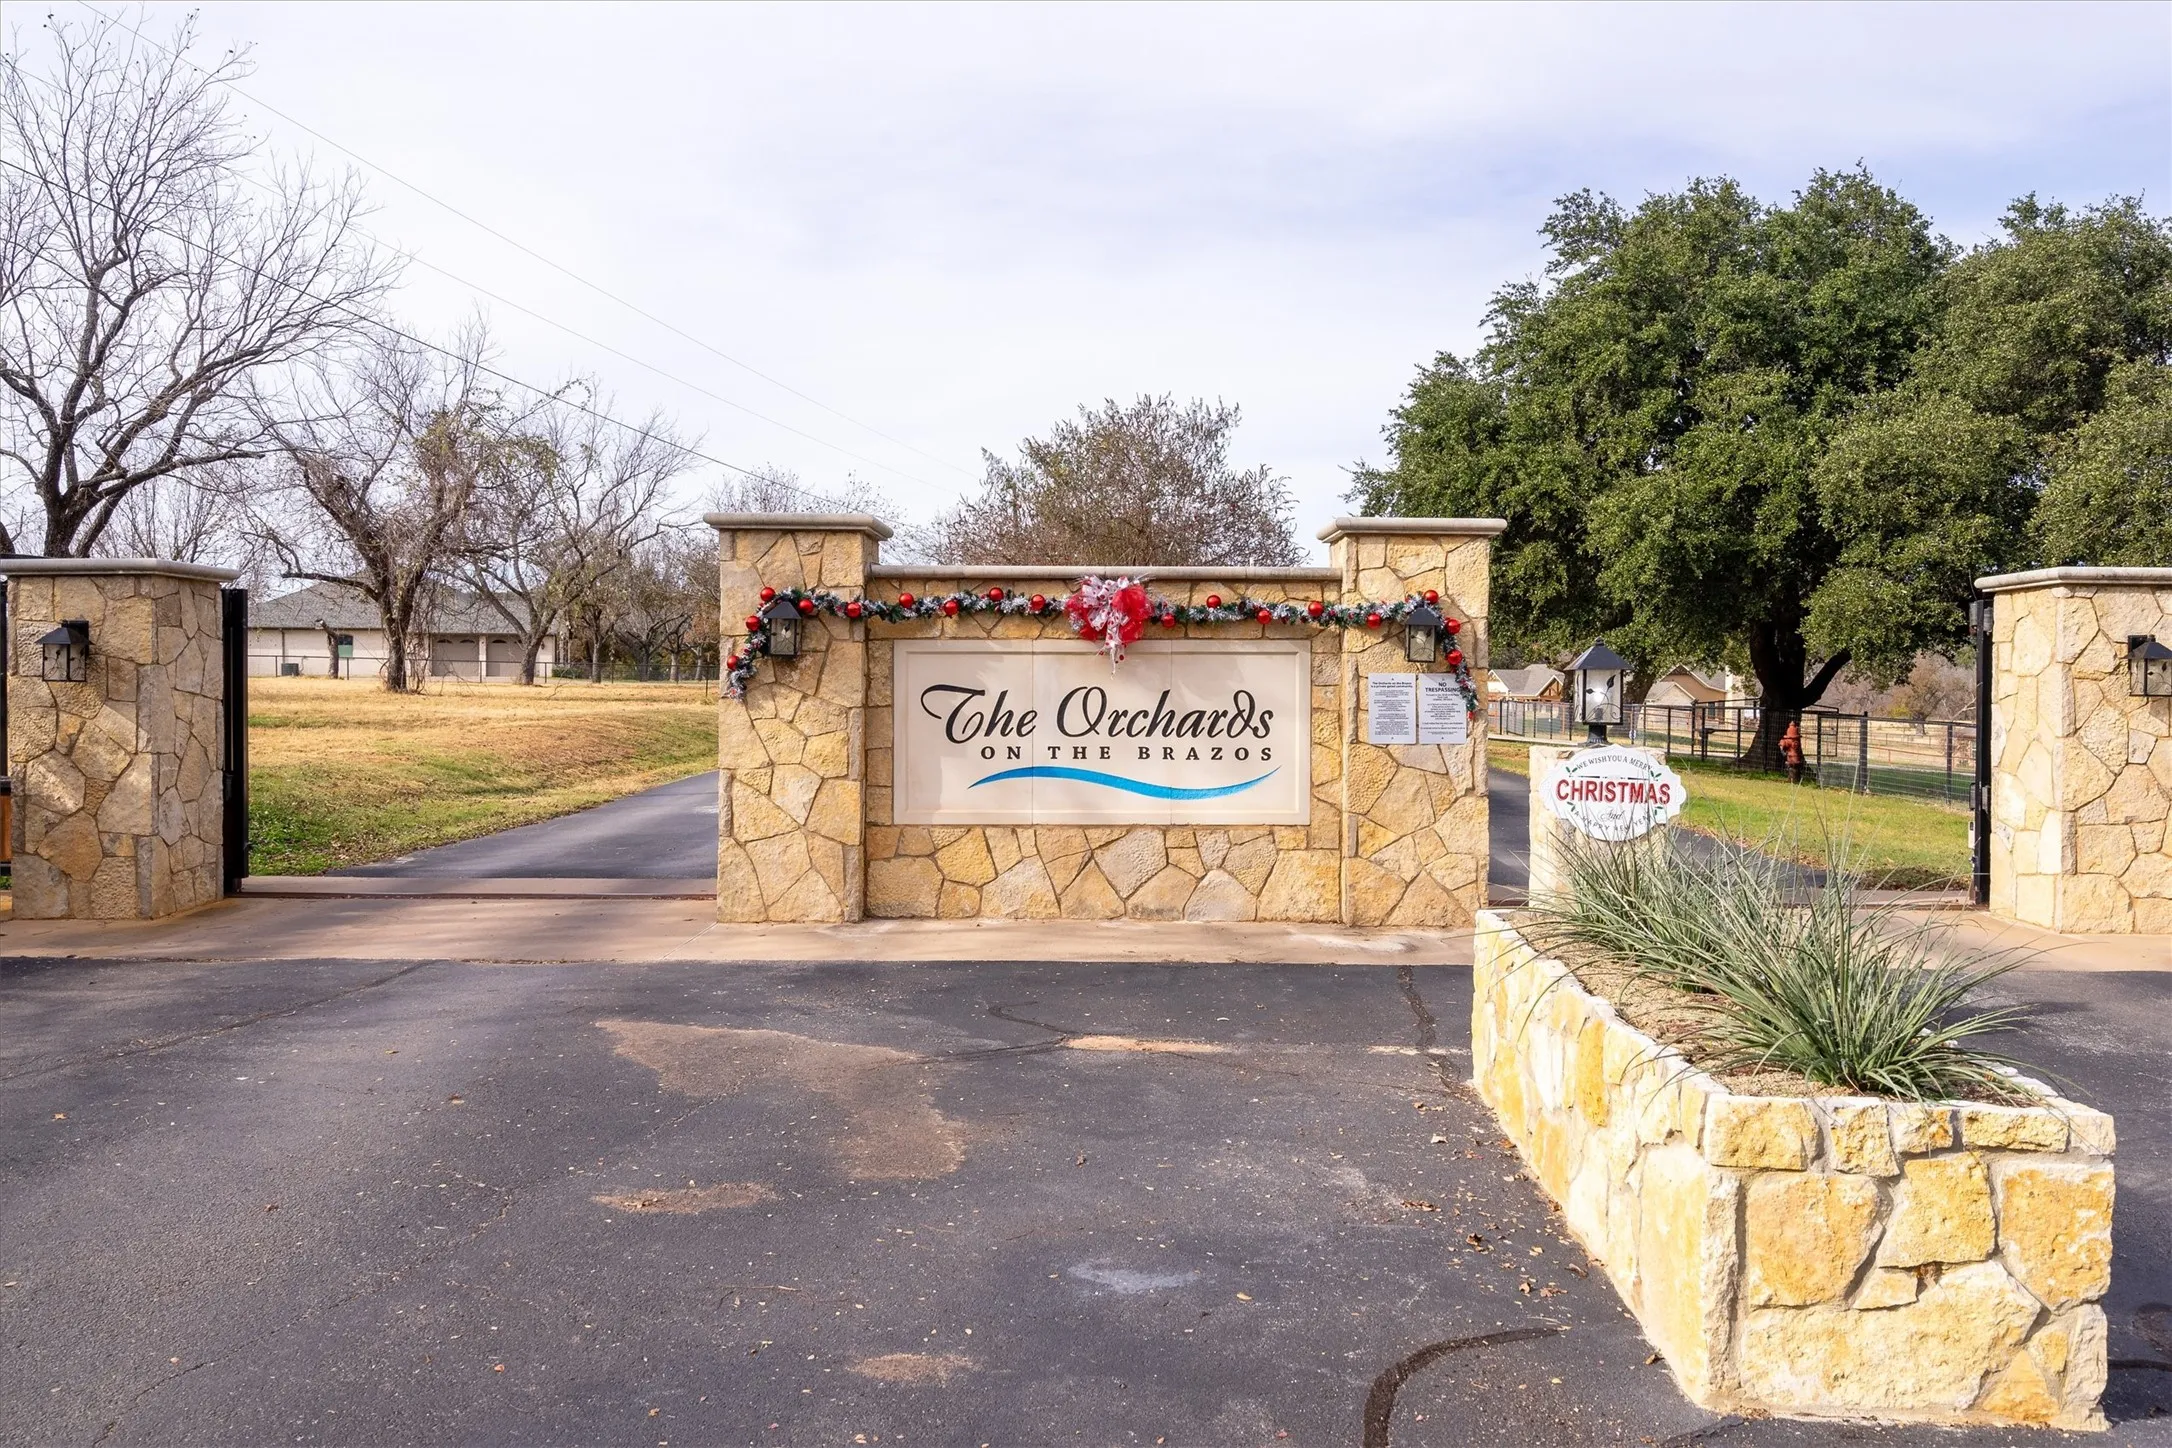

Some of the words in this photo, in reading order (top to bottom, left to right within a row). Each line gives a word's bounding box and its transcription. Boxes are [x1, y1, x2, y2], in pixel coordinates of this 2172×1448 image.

[920, 684, 1037, 744] The
[1056, 686, 1273, 739] Orchards
[980, 745, 1022, 761] ON
[1048, 745, 1112, 761] THE
[1138, 745, 1273, 761] BRAZOS
[1577, 761, 1588, 770] WE
[1588, 755, 1607, 765] WISH
[1629, 758, 1653, 771] MERRY
[1556, 779, 1671, 805] CHRISTMAS
[1599, 808, 1625, 821] And
